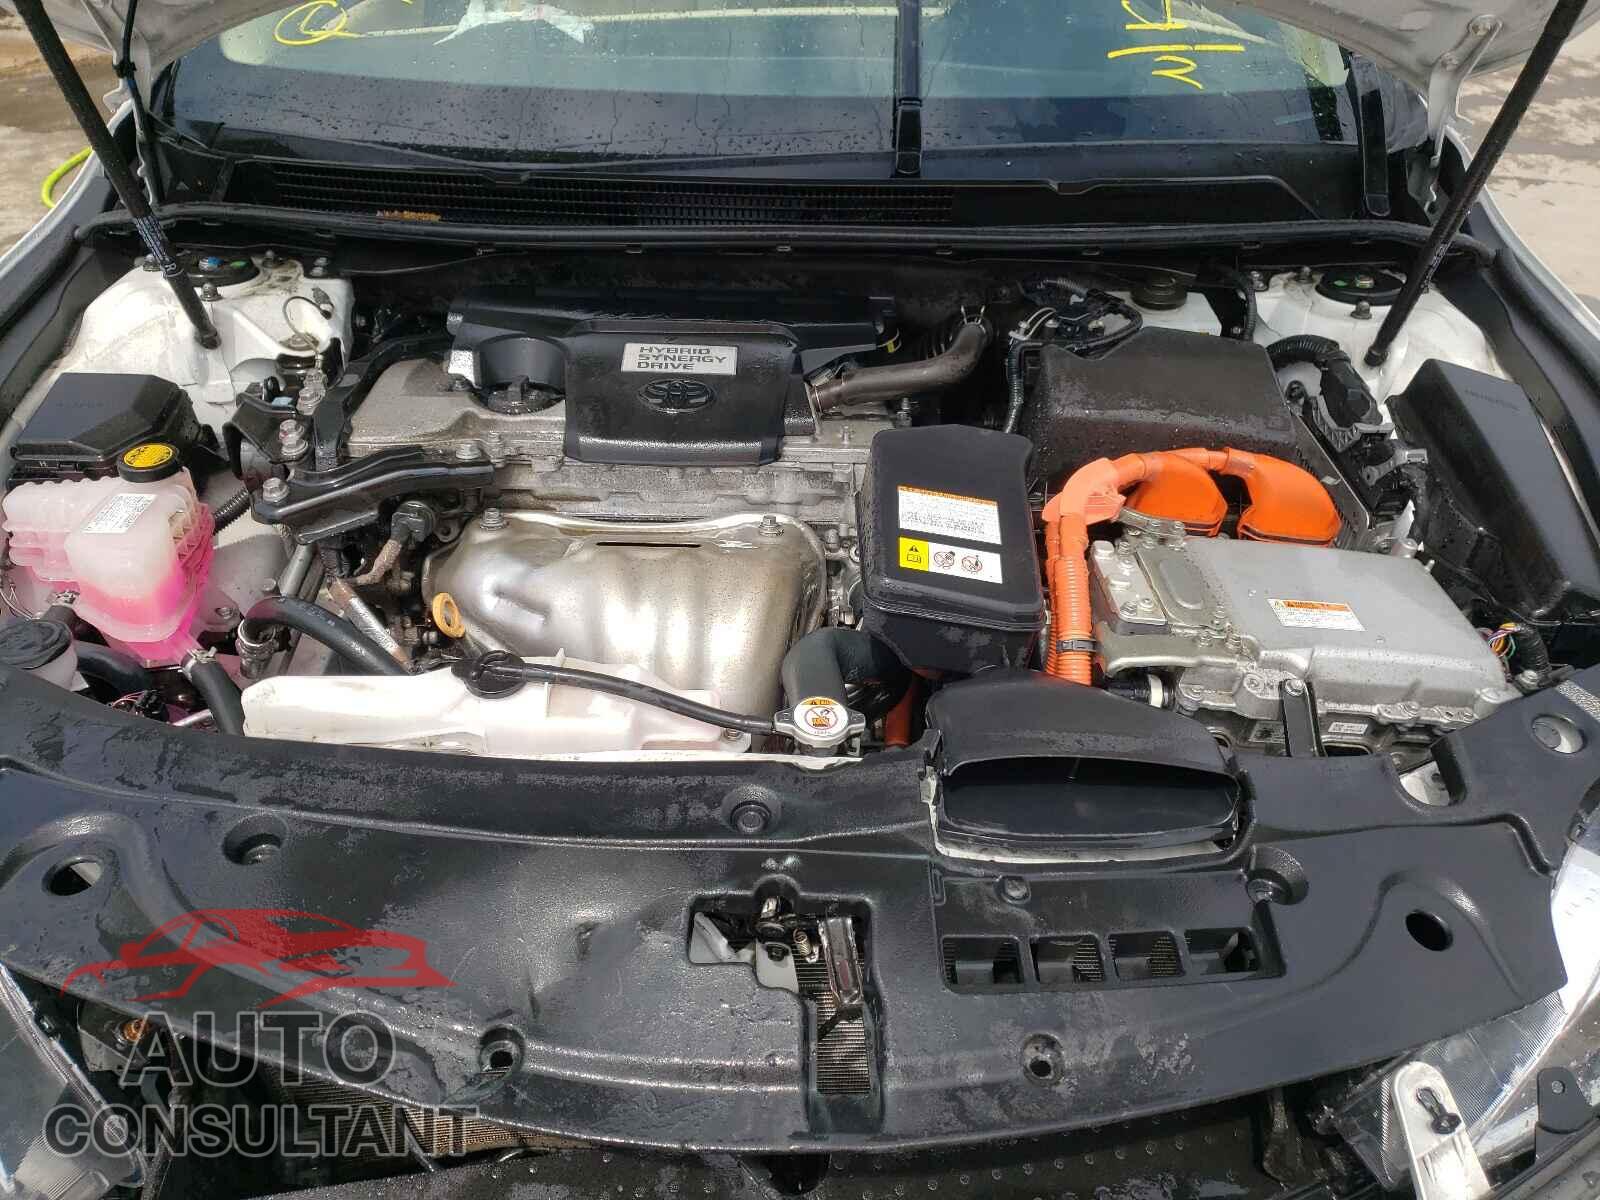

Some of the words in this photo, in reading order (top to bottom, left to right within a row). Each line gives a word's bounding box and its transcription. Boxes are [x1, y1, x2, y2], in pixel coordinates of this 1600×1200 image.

[639, 346, 711, 355] HYBRID
[638, 353, 727, 363] SYNERGY
[637, 361, 695, 370] DRIVE
